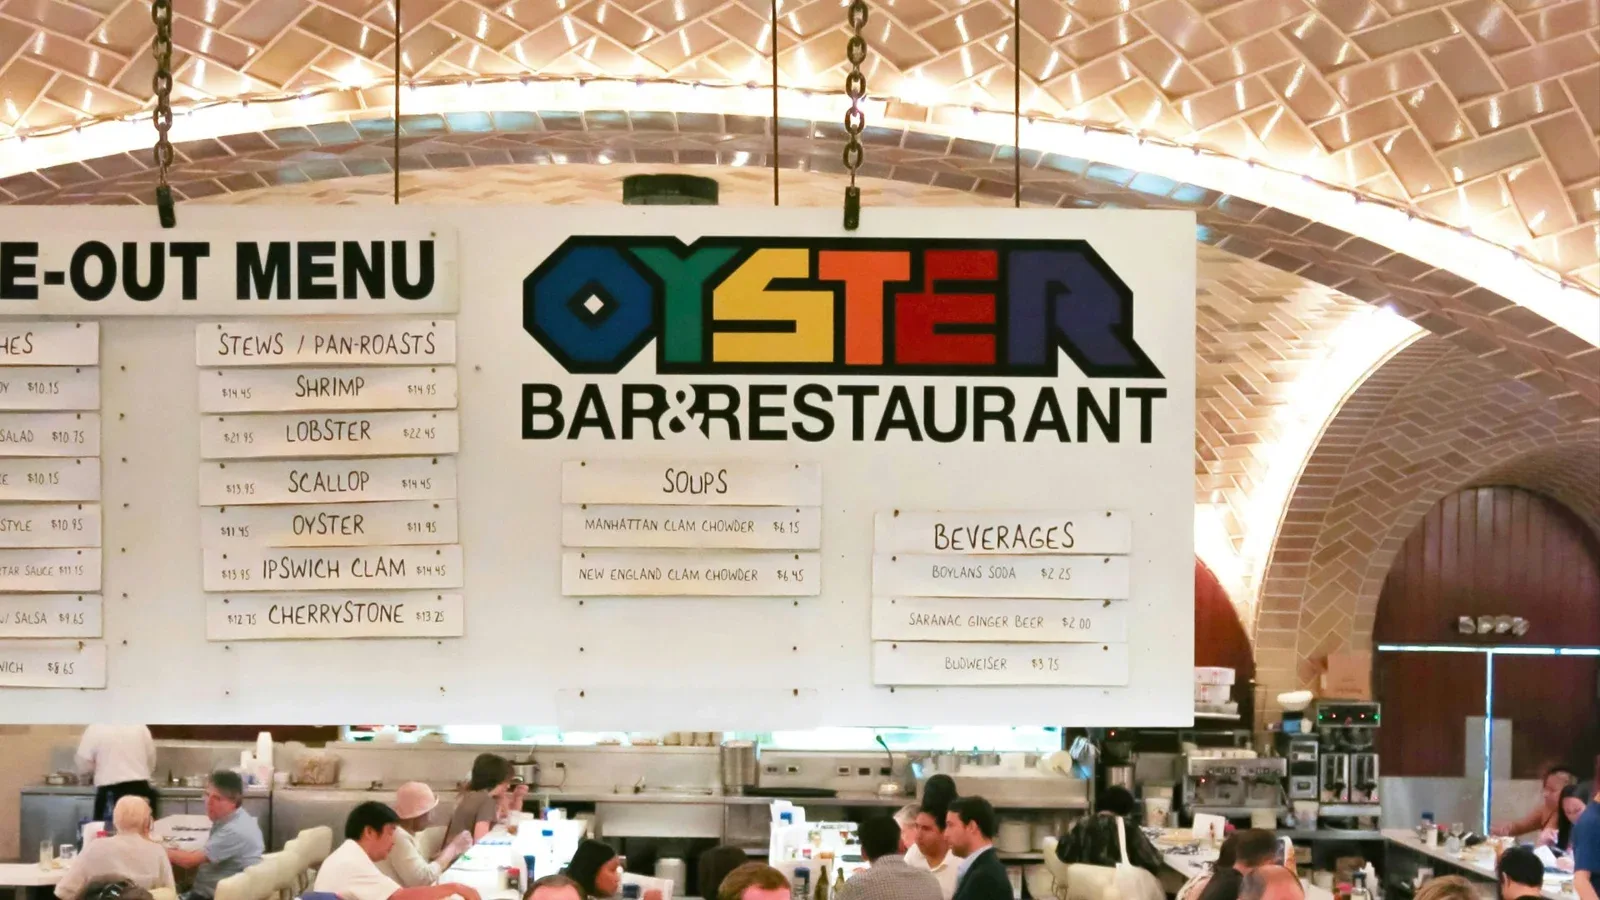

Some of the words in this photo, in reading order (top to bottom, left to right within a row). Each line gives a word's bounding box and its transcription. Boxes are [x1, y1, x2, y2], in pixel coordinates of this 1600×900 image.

[0, 241, 210, 301] E-OUT
[236, 240, 434, 300] MENU
[523, 236, 1166, 378] OYSTER
[219, 332, 283, 356] STEWS
[315, 332, 435, 354] PAN-ROASTS
[27, 381, 59, 394] $10.15
[295, 374, 364, 397] SHRIMP
[0, 429, 33, 443] SALAD
[287, 418, 370, 442] LOBSTER
[288, 470, 369, 492] SCALLOP
[663, 468, 727, 494] SOUPS
[0, 518, 32, 531] STYLE
[293, 512, 364, 535] OYSTER
[586, 518, 658, 531] MANHATTAN
[664, 519, 695, 531] CLAM
[702, 519, 754, 533] CHOWDER
[935, 522, 1074, 550] BEVERAGES
[24, 563, 53, 576] SAUCE
[264, 556, 339, 579] IPSWICH
[351, 556, 405, 577] CLAM
[579, 568, 604, 580] NEW
[611, 567, 661, 580] ENGLAND
[668, 568, 699, 580] CLAM
[705, 568, 757, 581] CHOWDER
[932, 565, 982, 578] BOYLANS
[988, 565, 1016, 579] SODA
[15, 611, 47, 624] SALSA
[269, 600, 403, 624] CHERRYSTONE
[909, 613, 961, 626] SARANAC
[968, 615, 1008, 627] GINGER
[1015, 615, 1043, 628] BEER
[945, 656, 1006, 670] BUDWEISER
